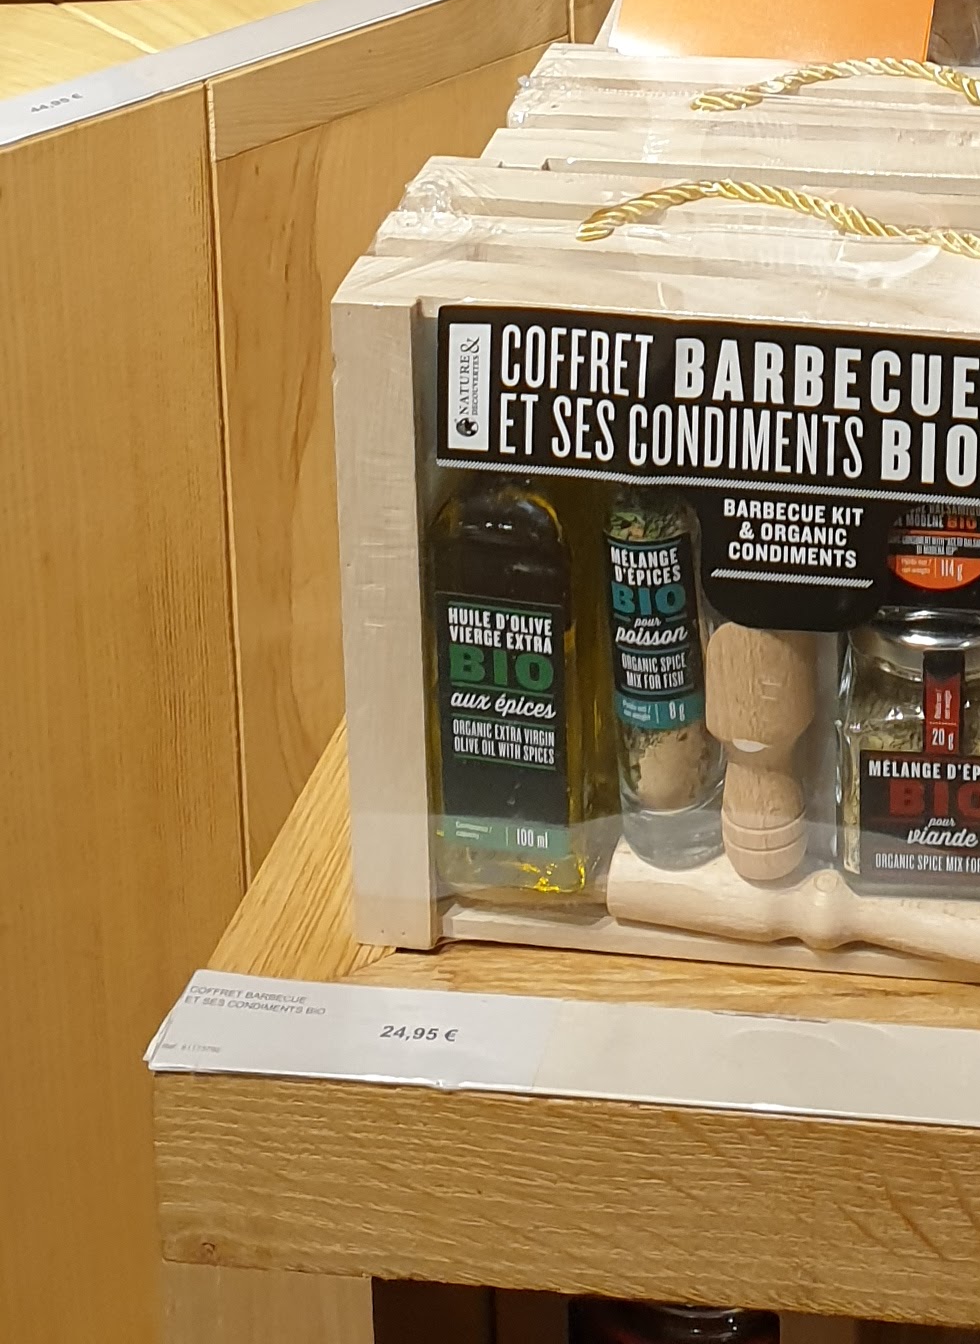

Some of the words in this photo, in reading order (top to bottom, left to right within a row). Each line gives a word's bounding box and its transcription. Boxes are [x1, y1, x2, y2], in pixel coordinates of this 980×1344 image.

[502, 323, 654, 399] COFFRET
[674, 337, 980, 420] BARBECUE
[500, 393, 536, 455] ET
[551, 394, 615, 463] SES
[628, 404, 864, 480] CONDIMENTS
[881, 419, 979, 487] BIO
[724, 498, 825, 522] BARBECUE
[832, 507, 863, 527] KIT
[761, 523, 847, 547] ORGANIC
[610, 546, 678, 568] MÉLANGE
[728, 541, 857, 569] CONDIMENTS
[615, 565, 681, 585] D'ÉPICES
[611, 581, 686, 615] BIO
[448, 608, 491, 628] HUILE
[496, 614, 552, 636] D'OLIVE
[449, 625, 501, 648] VIERGE
[506, 632, 552, 654] EXTRA
[615, 624, 688, 646] poisson
[450, 643, 554, 691] BIO
[621, 652, 658, 673] ORGANIC
[660, 652, 686, 673] SPICE
[451, 692, 491, 710] aux
[495, 693, 556, 719] épices
[453, 719, 492, 739] ORGANIC
[495, 724, 522, 743] EXTRA
[524, 728, 554, 747] VIRGIN
[454, 736, 479, 754] OLIVE
[498, 742, 520, 759] WITH
[523, 746, 554, 764] SPICES
[868, 760, 941, 779] MÉLANGE
[907, 828, 978, 848] viande
[875, 853, 915, 869] ORGANIC
[917, 855, 943, 871] SPICE
[946, 856, 964, 872] MIX
[190, 986, 242, 998] COFFRET
[245, 992, 307, 1003] BARBECUE
[203, 998, 225, 1006] SES
[227, 1000, 303, 1014] CONDIMENTS
[306, 1007, 326, 1015] BIO
[380, 1025, 438, 1042] 24,95
[444, 1028, 459, 1043] €
